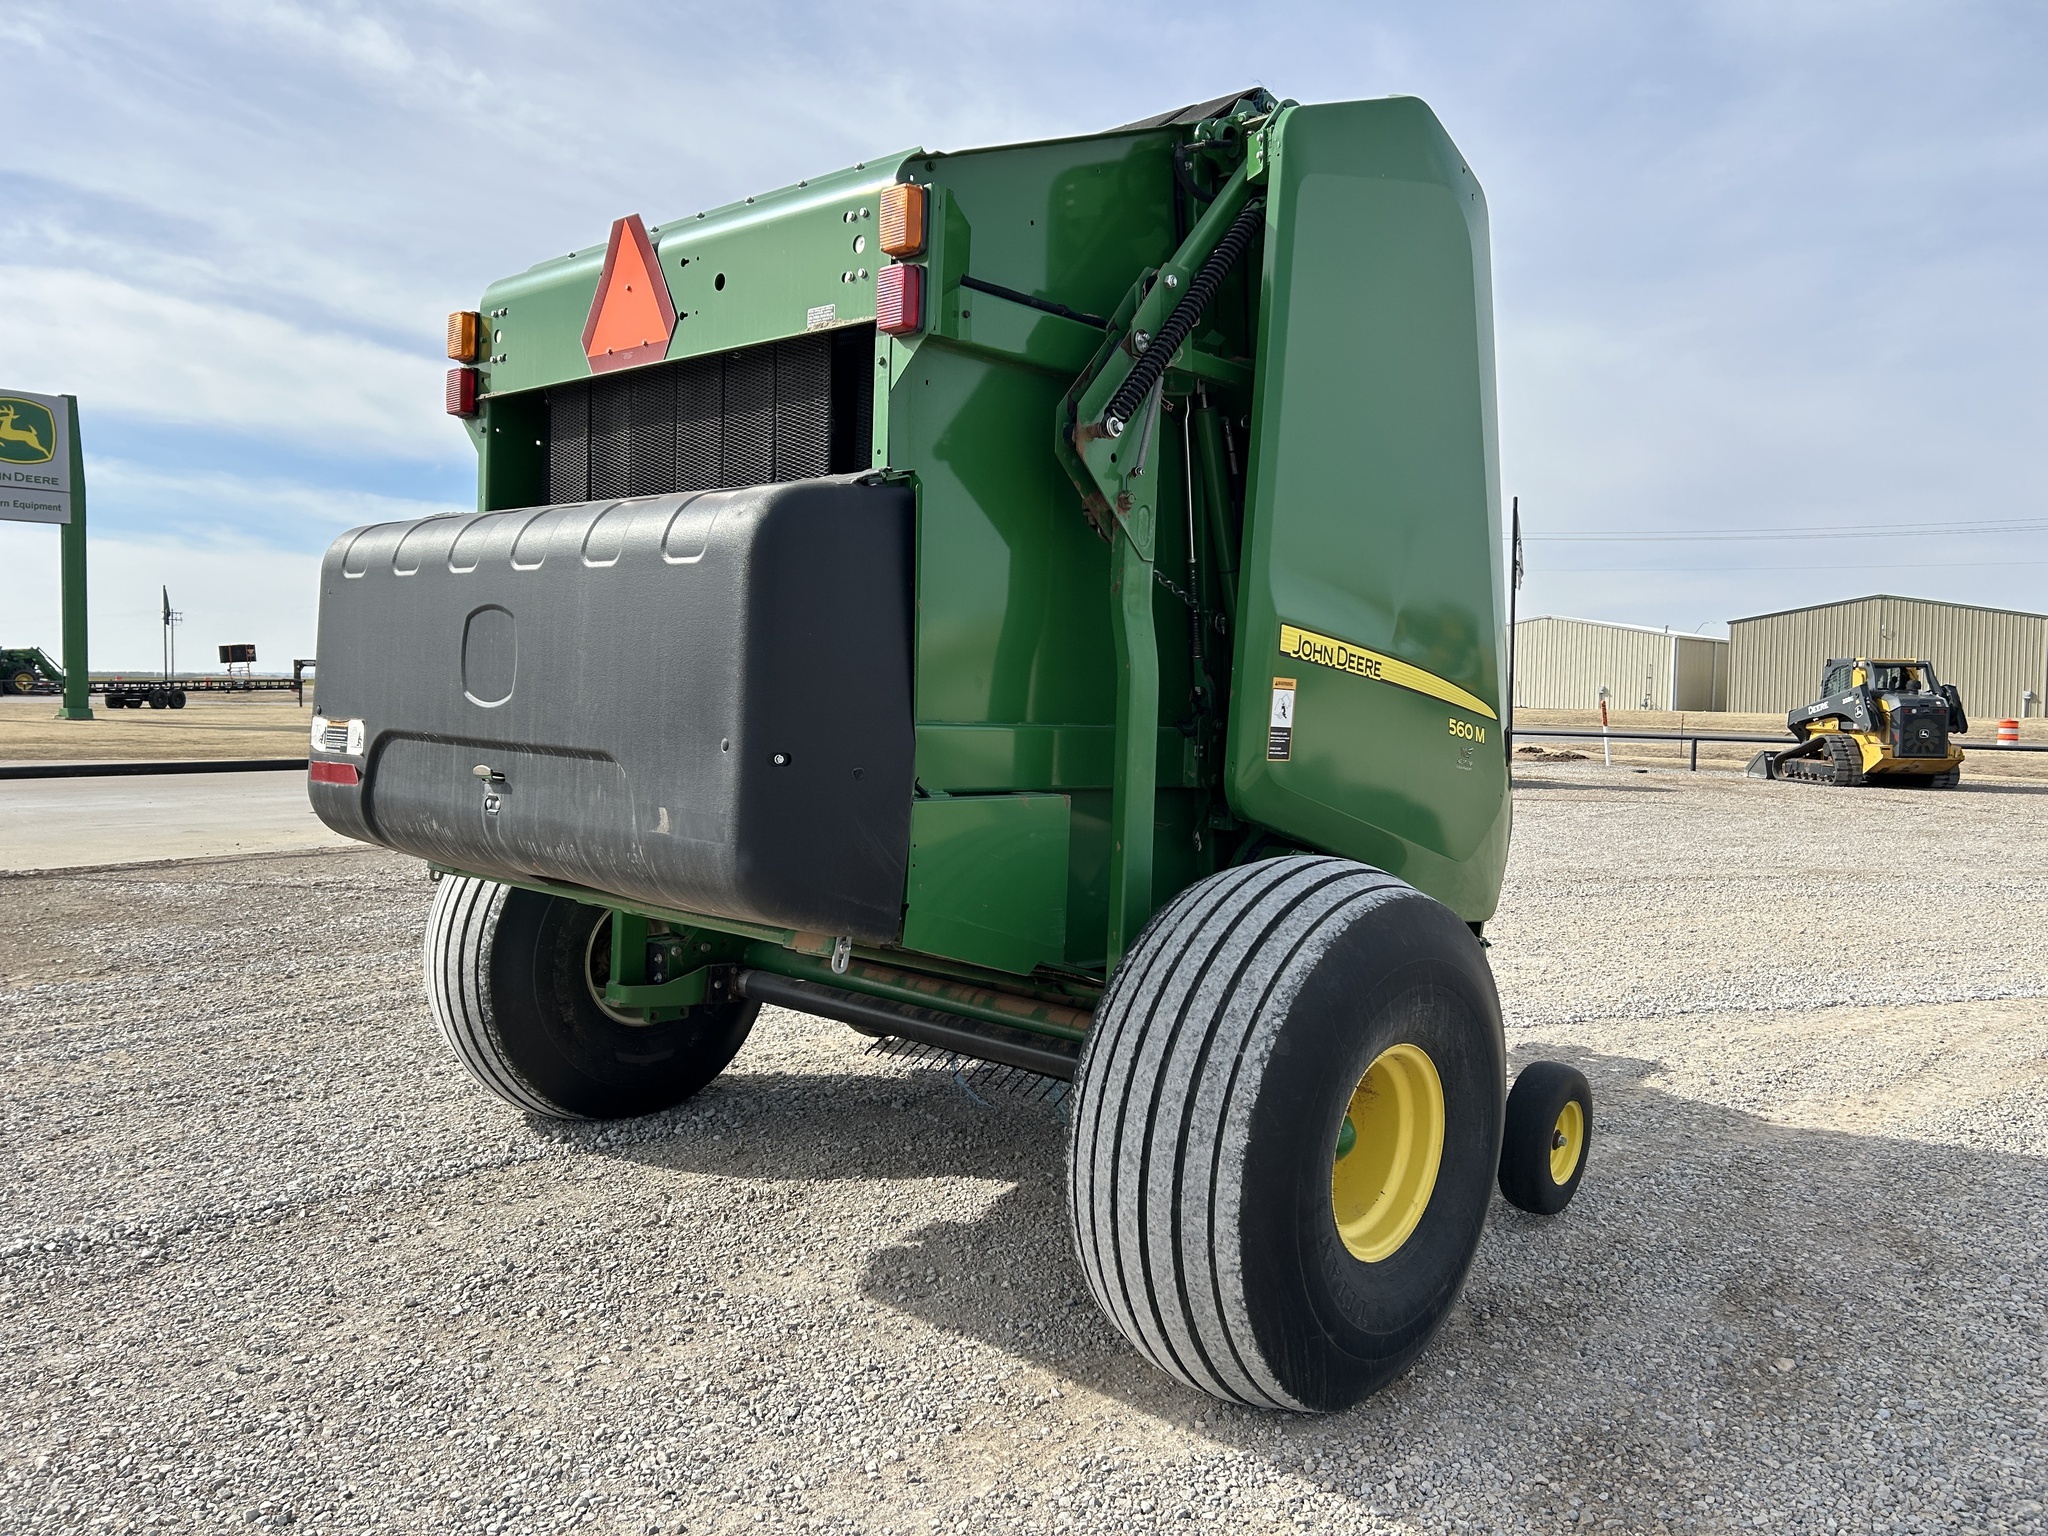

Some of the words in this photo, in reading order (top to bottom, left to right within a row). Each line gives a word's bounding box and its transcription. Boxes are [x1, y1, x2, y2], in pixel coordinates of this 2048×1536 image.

[14, 472, 59, 486] DEERE
[13, 500, 62, 511] Equipment
[1292, 635, 1334, 664] JOHN
[1337, 645, 1382, 677] DEERE
[1808, 701, 1829, 715] DEERE
[1449, 717, 1473, 740] 560
[1475, 725, 1485, 744] M
